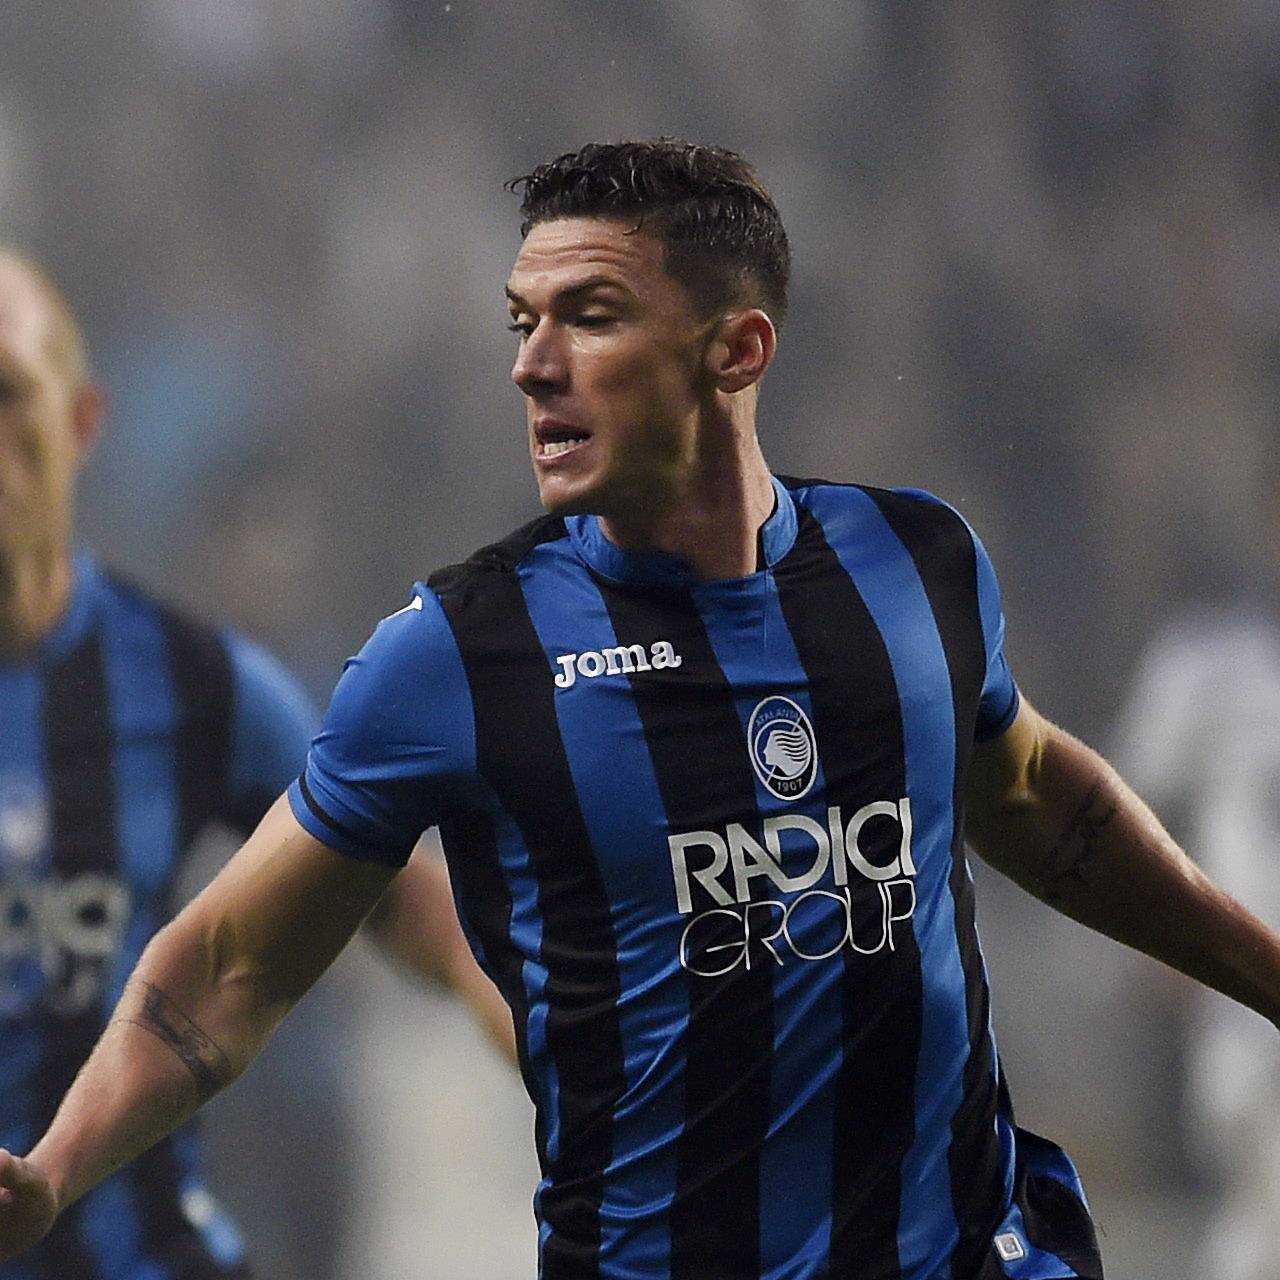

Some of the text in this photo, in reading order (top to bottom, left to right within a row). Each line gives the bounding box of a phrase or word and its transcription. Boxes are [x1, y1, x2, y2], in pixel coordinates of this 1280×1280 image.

[776, 777, 803, 792] 1907
[668, 798, 917, 914] RADICI
[680, 880, 917, 977] GROUP
